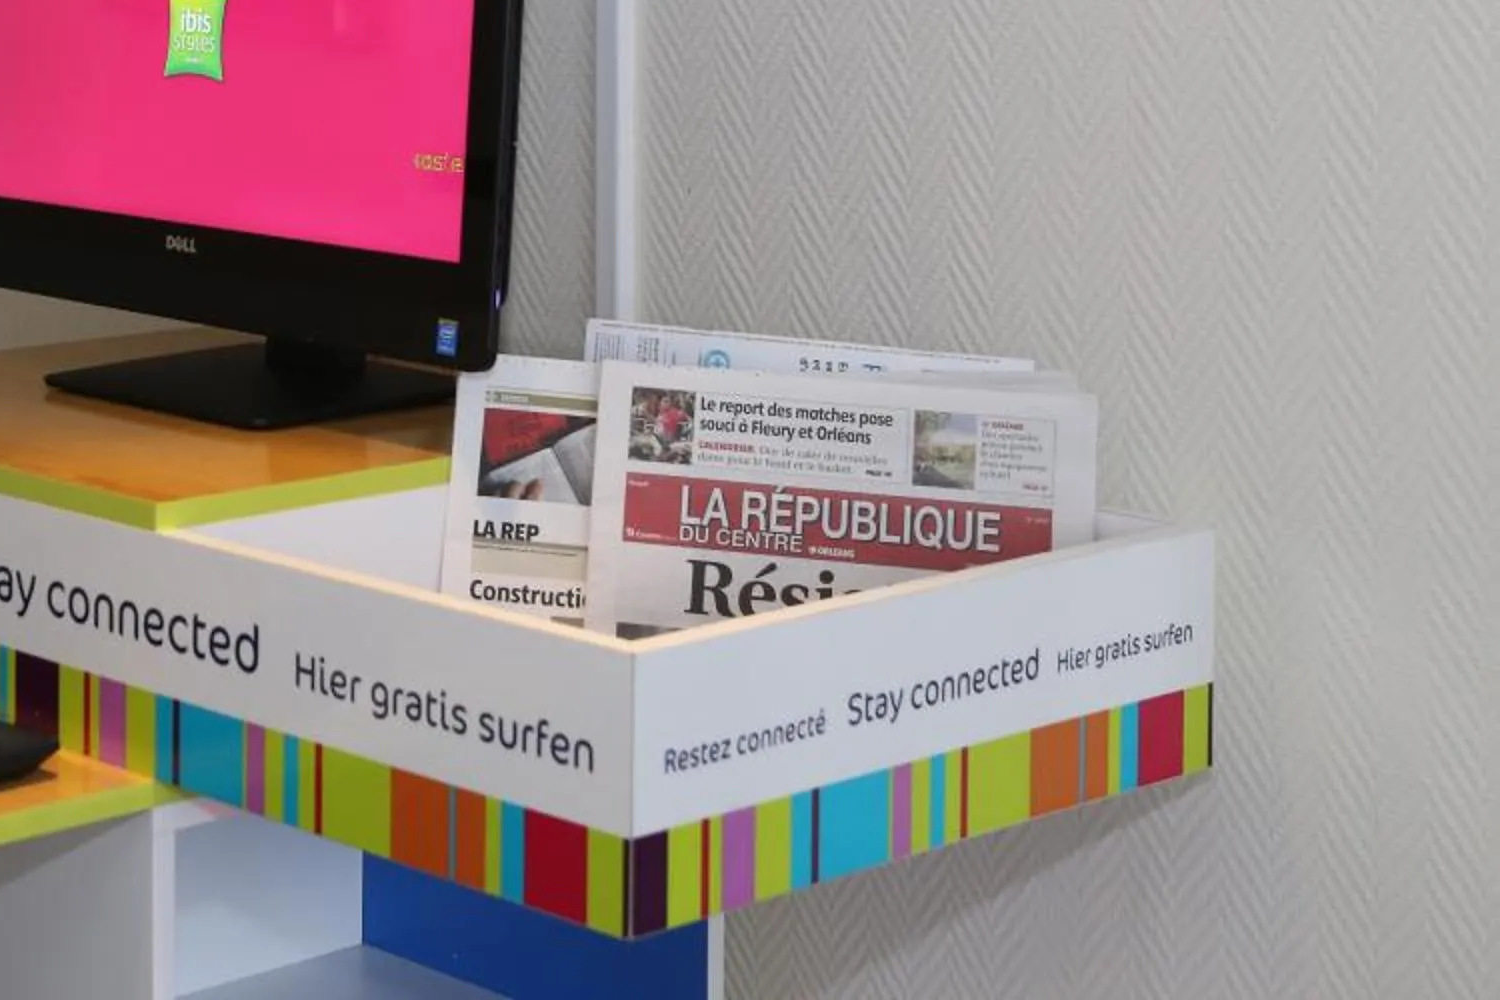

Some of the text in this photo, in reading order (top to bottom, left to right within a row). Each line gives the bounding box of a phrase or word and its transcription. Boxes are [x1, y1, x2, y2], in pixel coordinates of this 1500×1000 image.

[180, 8, 211, 33] ibis
[165, 234, 197, 253] DELL
[700, 396, 714, 411] Le
[719, 400, 764, 418] report
[767, 403, 792, 418] des
[795, 406, 855, 423] matches
[700, 418, 735, 433] souci
[752, 420, 795, 442] Fleury
[799, 426, 813, 439] et
[817, 424, 872, 445] Orléans
[473, 519, 539, 542] LA REP
[681, 484, 1001, 552] LA RÉPUBLIQUE
[680, 524, 709, 543] DU
[716, 528, 803, 552] CENTRE
[469, 579, 586, 610] Constructi
[684, 558, 863, 618] Rési
[48, 579, 260, 674] connected
[295, 653, 361, 703] Hier
[370, 680, 467, 735] gratis
[479, 710, 595, 774] surfen
[664, 622, 1194, 774] Restez connecté Stay connected Hier gratis surfen
